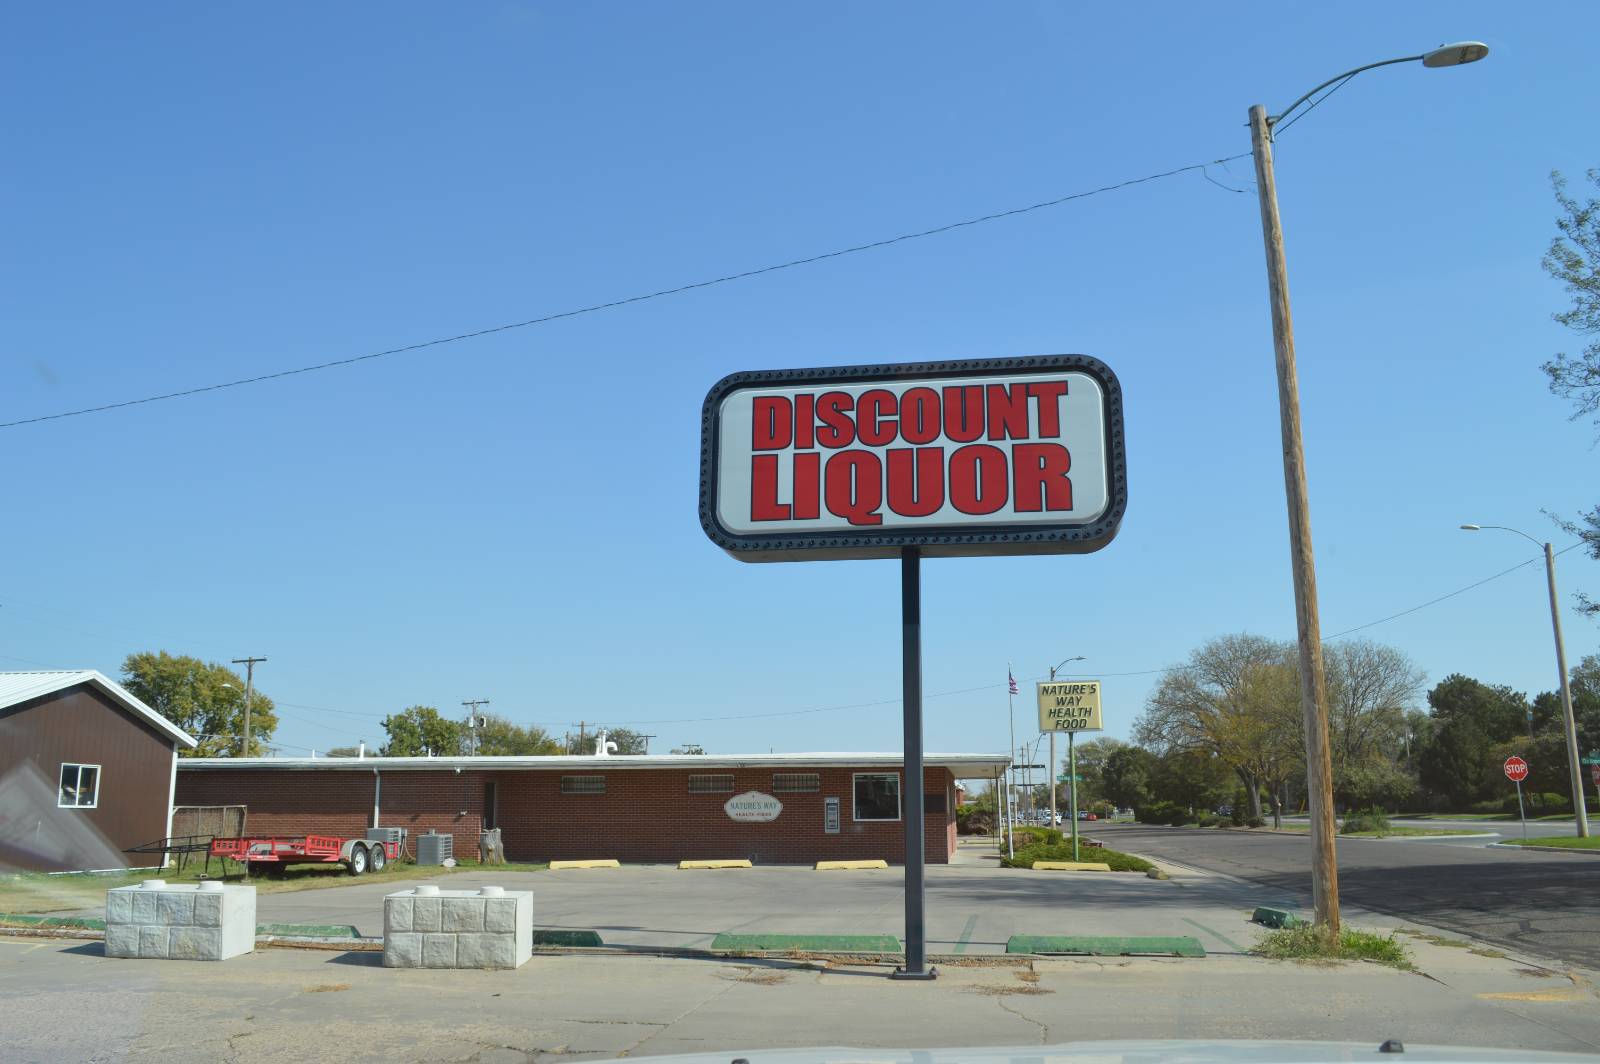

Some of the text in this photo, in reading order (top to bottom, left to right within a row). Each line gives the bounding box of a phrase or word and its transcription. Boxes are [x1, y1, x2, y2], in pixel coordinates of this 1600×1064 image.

[751, 380, 1068, 451] DISCOUNT
[750, 443, 1073, 525] LIQUOR
[1042, 684, 1096, 695] NATURE'S
[1057, 696, 1082, 705] WAY
[1049, 707, 1092, 718] HEALTH
[1056, 719, 1087, 729] FOOD
[1506, 764, 1526, 774] STOP
[730, 801, 777, 809] NATURE'S WAY
